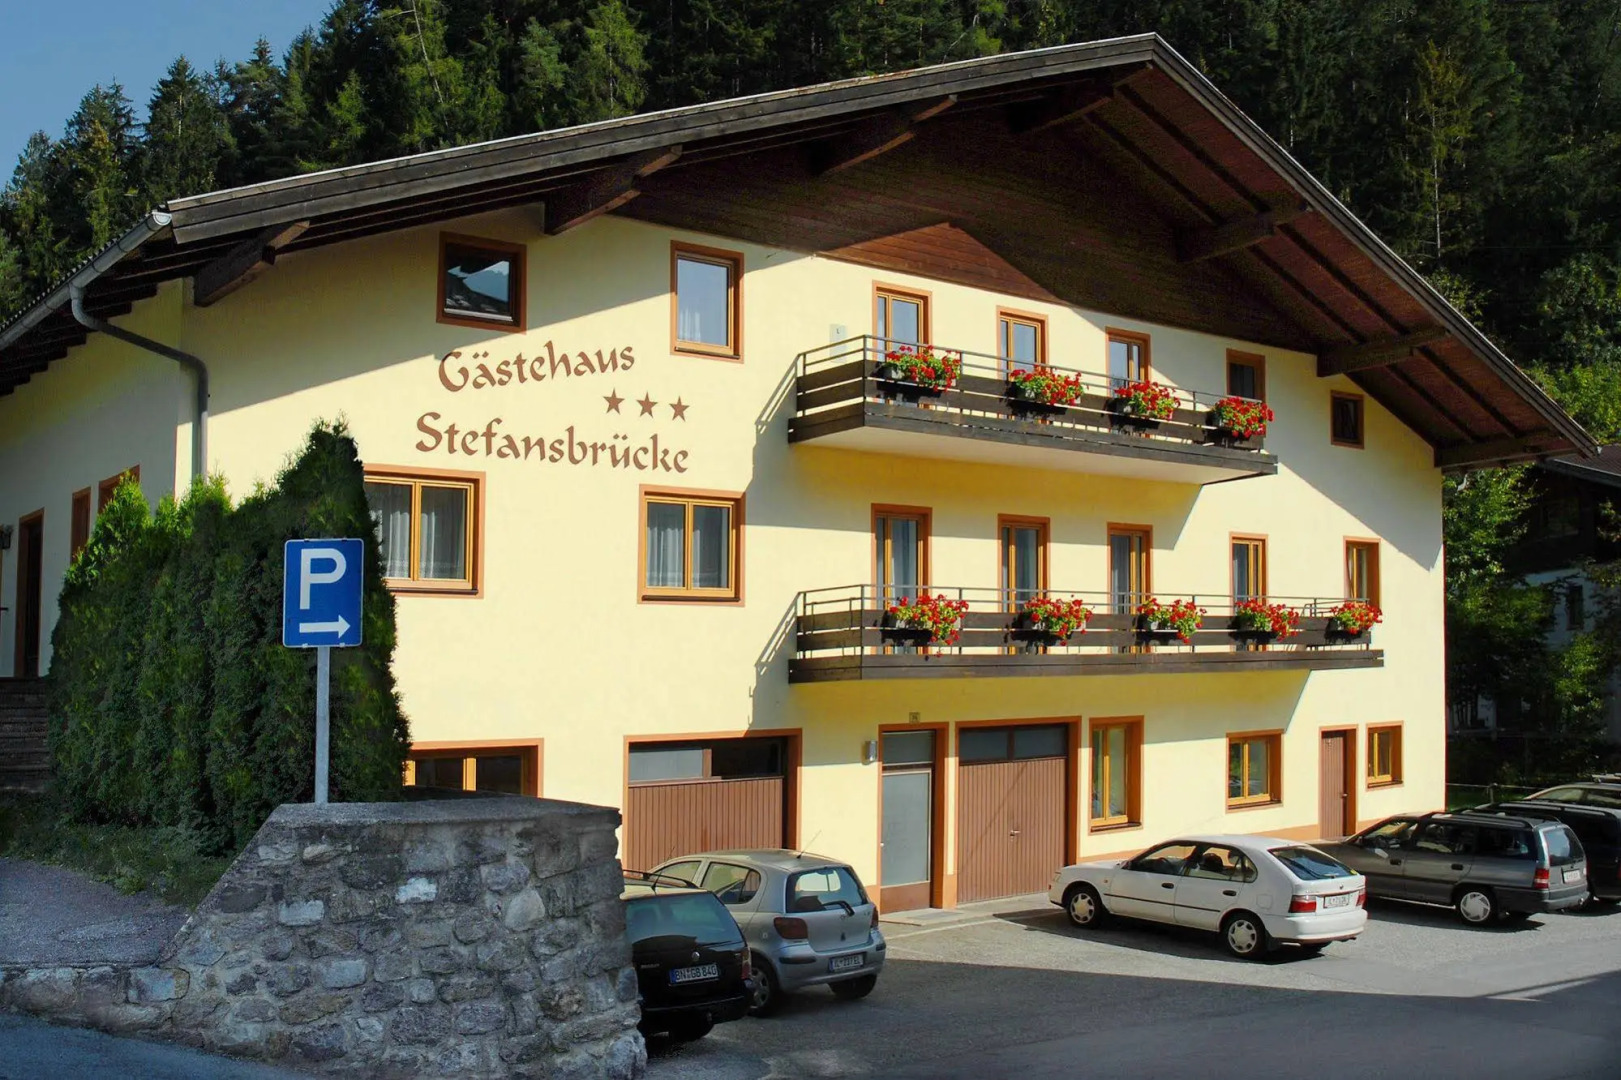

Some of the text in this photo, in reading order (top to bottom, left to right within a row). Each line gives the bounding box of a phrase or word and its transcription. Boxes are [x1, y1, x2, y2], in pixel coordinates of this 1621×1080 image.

[438, 340, 635, 392] Gästehaus
[415, 412, 689, 473] Stefansbrücke
[299, 548, 347, 610] P
